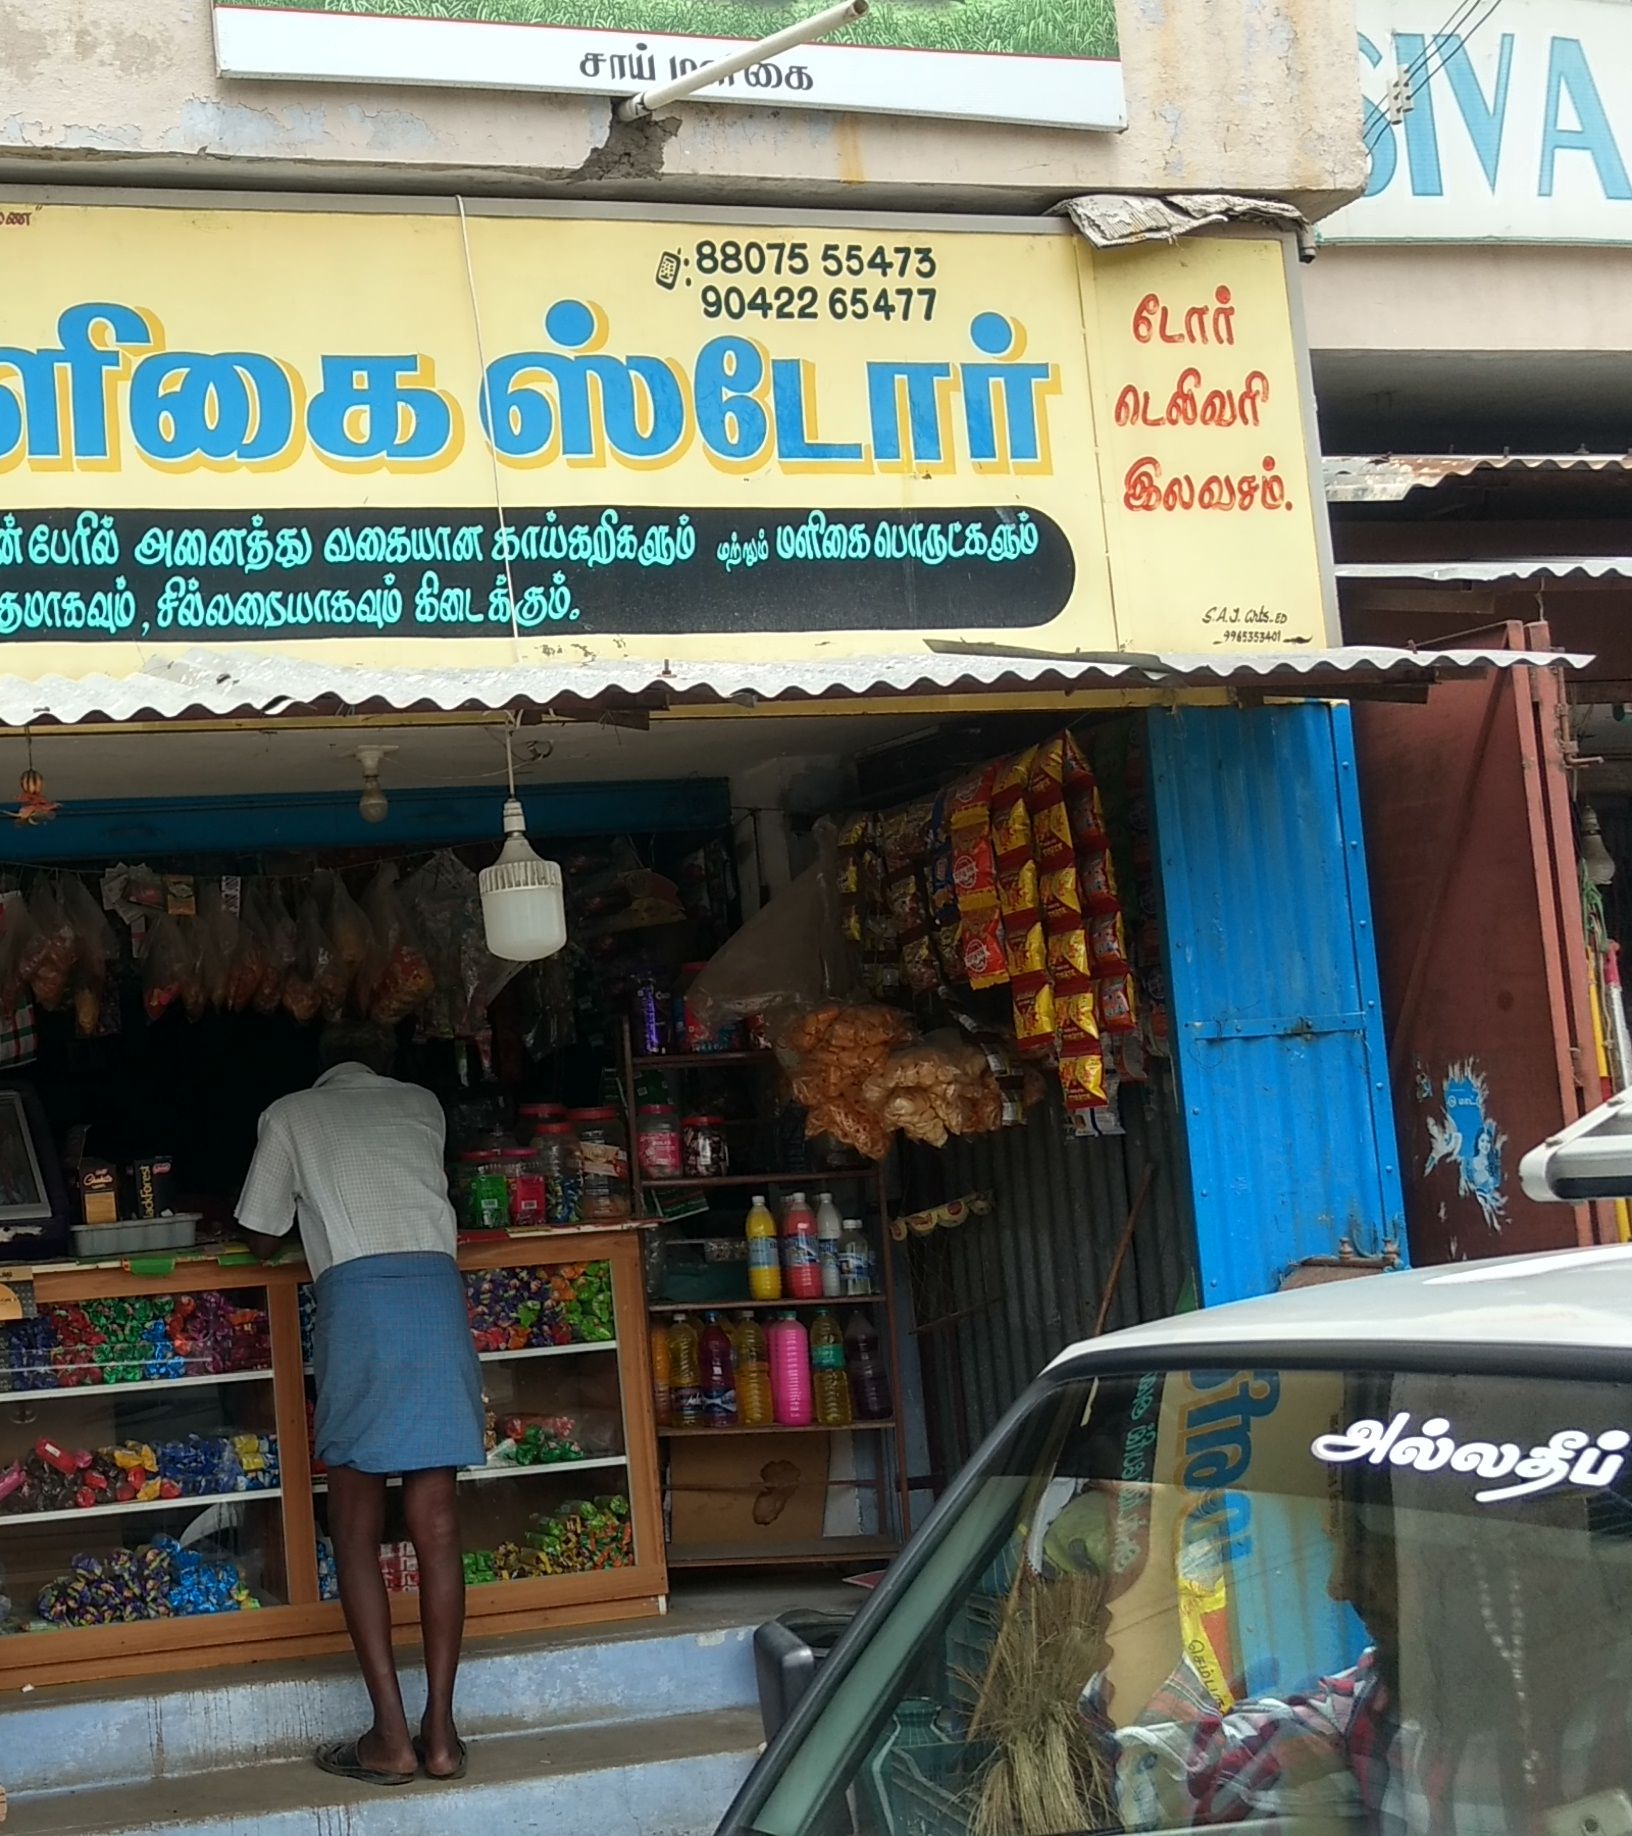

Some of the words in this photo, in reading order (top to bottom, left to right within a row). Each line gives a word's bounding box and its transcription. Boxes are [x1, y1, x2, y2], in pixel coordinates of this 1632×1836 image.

[579, 42, 656, 81] சாய்
[822, 243, 937, 278] 55473
[701, 285, 818, 320] 90422
[828, 287, 937, 321] 65477
[1132, 284, 1236, 345] டோர்
[479, 298, 1058, 468] ஸ்டோர்
[1114, 367, 1270, 427] டெலிவரி
[27, 510, 119, 566] பேரில்
[134, 514, 312, 574] அனைத்து
[324, 522, 484, 565] வகையான
[491, 508, 696, 568] காய்கறிகளும்
[716, 528, 769, 573] மற்றும்
[776, 508, 871, 562] மளிகை
[875, 510, 1040, 566] பொருட்களும்
[1311, 1412, 1632, 1502] அல்லதீப்
